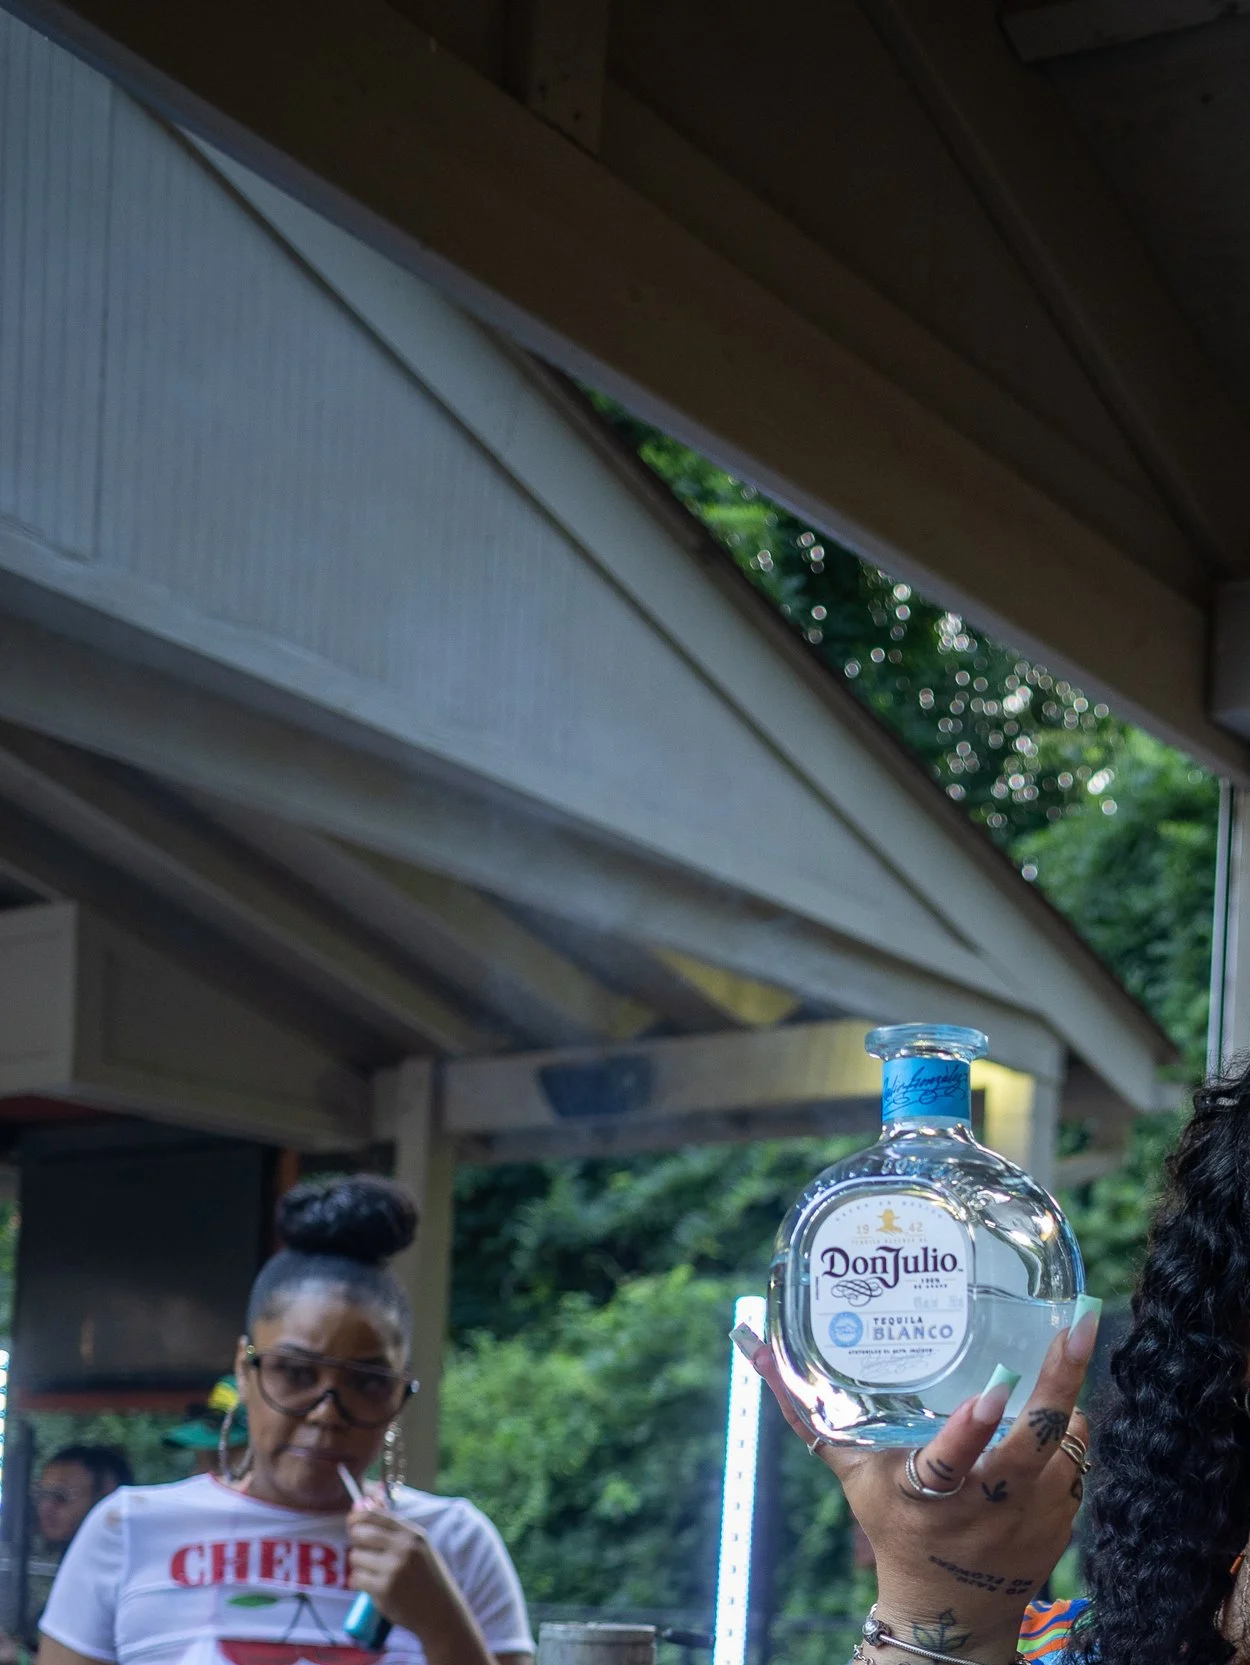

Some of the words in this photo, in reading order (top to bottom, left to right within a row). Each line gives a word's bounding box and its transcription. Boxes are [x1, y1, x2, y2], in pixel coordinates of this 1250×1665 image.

[875, 1246, 958, 1289] Julio
[873, 1316, 924, 1326] TEQUILA
[873, 1324, 954, 1341] BLANCO
[170, 1540, 352, 1588] CHER
